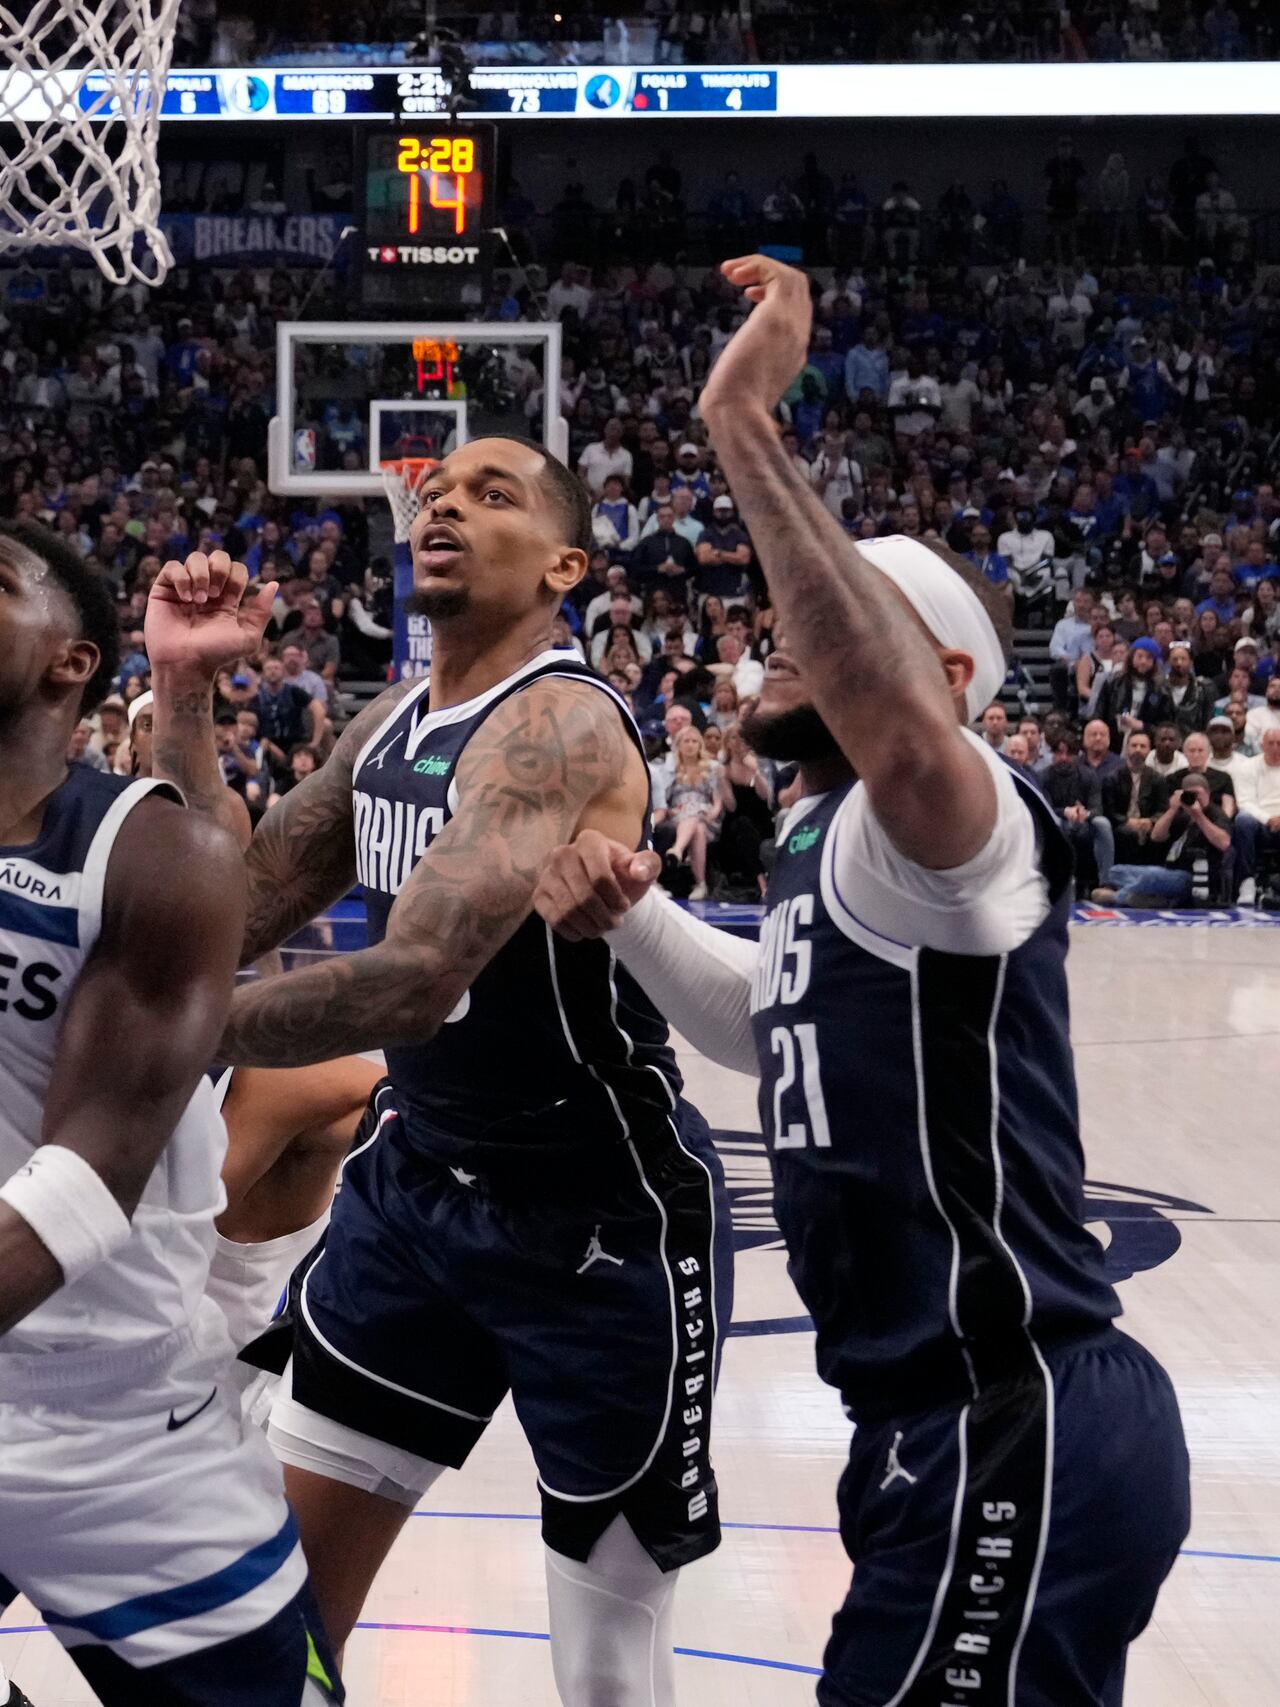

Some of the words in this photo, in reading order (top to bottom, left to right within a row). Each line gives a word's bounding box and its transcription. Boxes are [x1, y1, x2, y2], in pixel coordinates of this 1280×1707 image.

[282, 75, 374, 91] MAVERICKS
[468, 74, 578, 90] TIMBERWOLVES
[641, 74, 687, 88] FOULS
[701, 74, 771, 89] TIMEOUTS
[312, 90, 346, 114] 69
[508, 89, 540, 113] 73
[657, 88, 669, 111] 1
[725, 88, 742, 111] 4
[398, 138, 474, 173] 2:28
[409, 174, 465, 234] 14
[413, 755, 451, 778] chime
[770, 1022, 832, 1150] 21
[939, 1500, 1017, 1707] ERICKS
